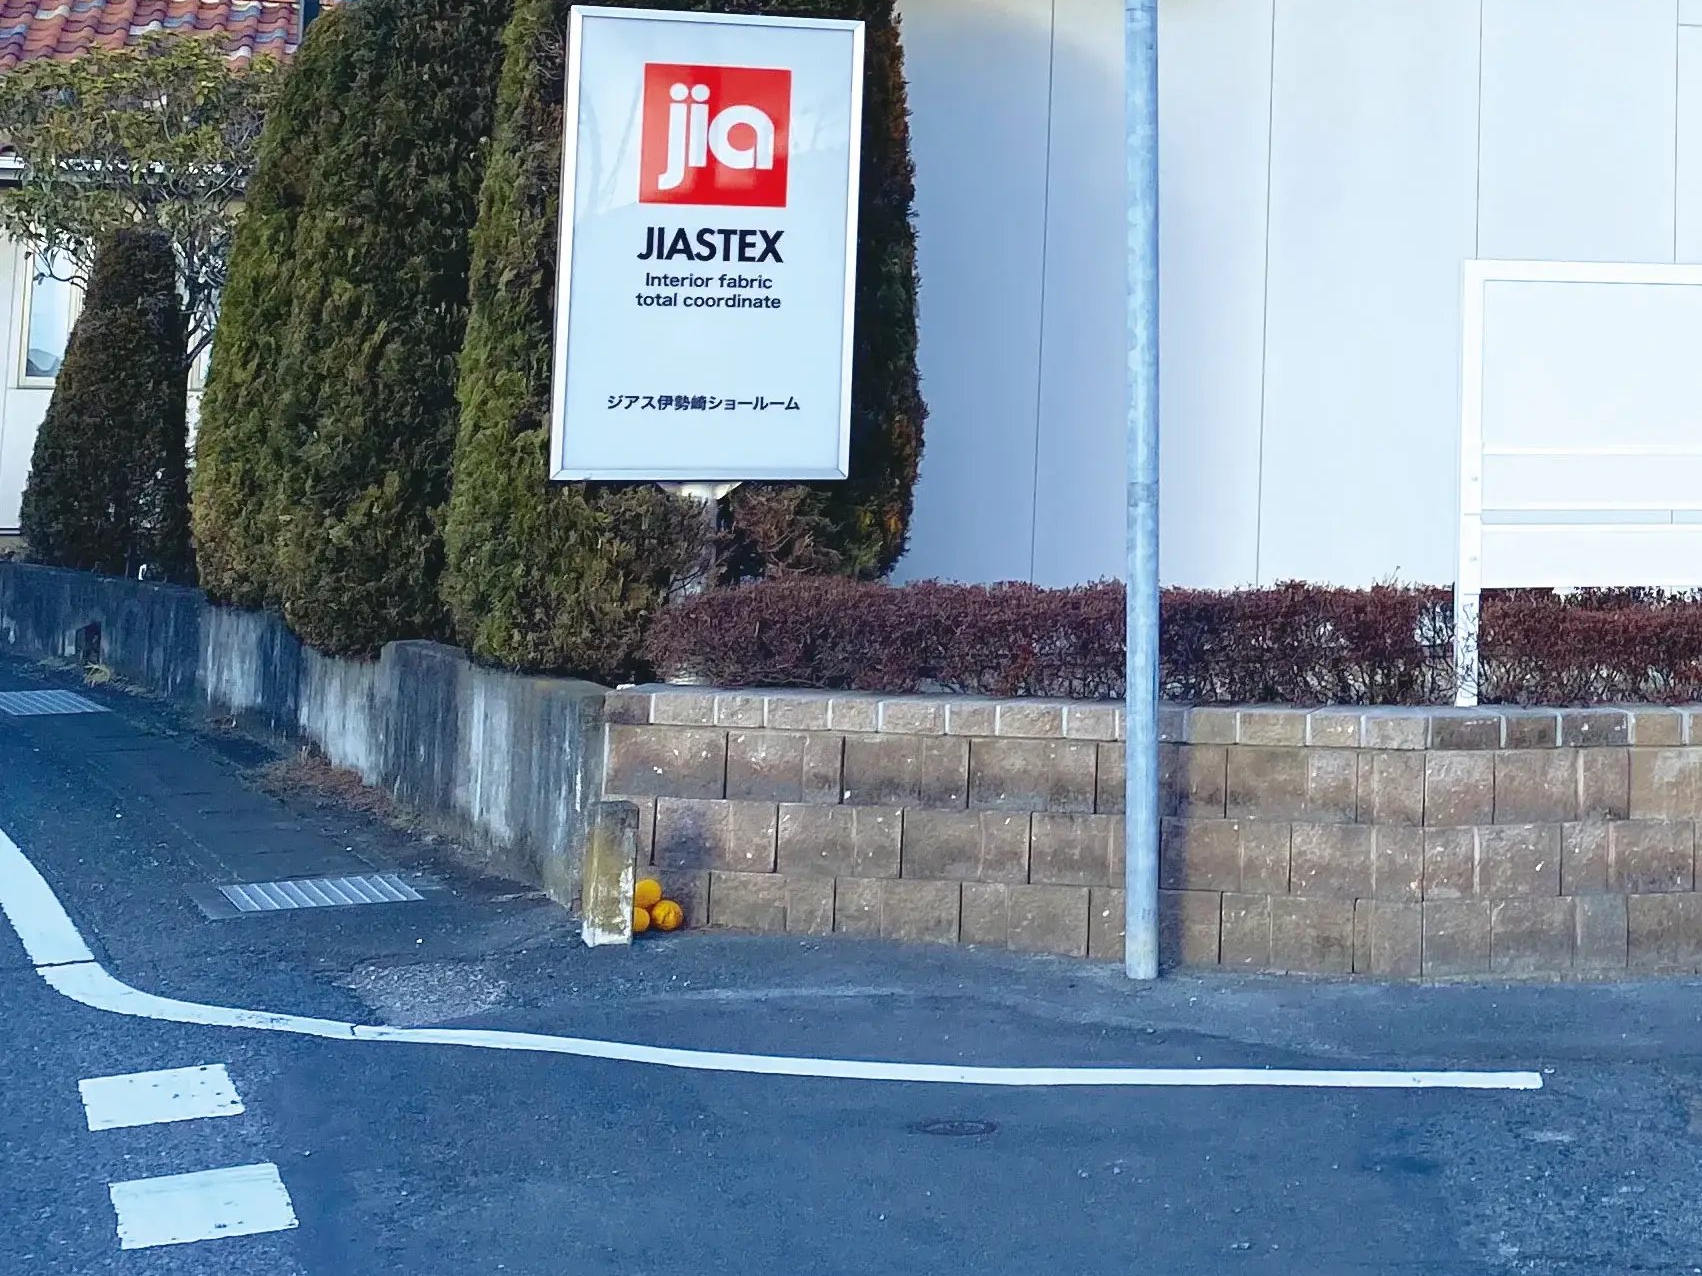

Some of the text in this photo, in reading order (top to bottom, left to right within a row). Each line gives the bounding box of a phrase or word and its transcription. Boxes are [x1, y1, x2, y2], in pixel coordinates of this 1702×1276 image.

[657, 83, 774, 189] jia
[636, 226, 785, 263] JIASTEX
[645, 272, 773, 290] Interior fabric
[636, 292, 781, 309] total coordinate
[607, 395, 800, 411] ジアス伊勢崎ショールーム
